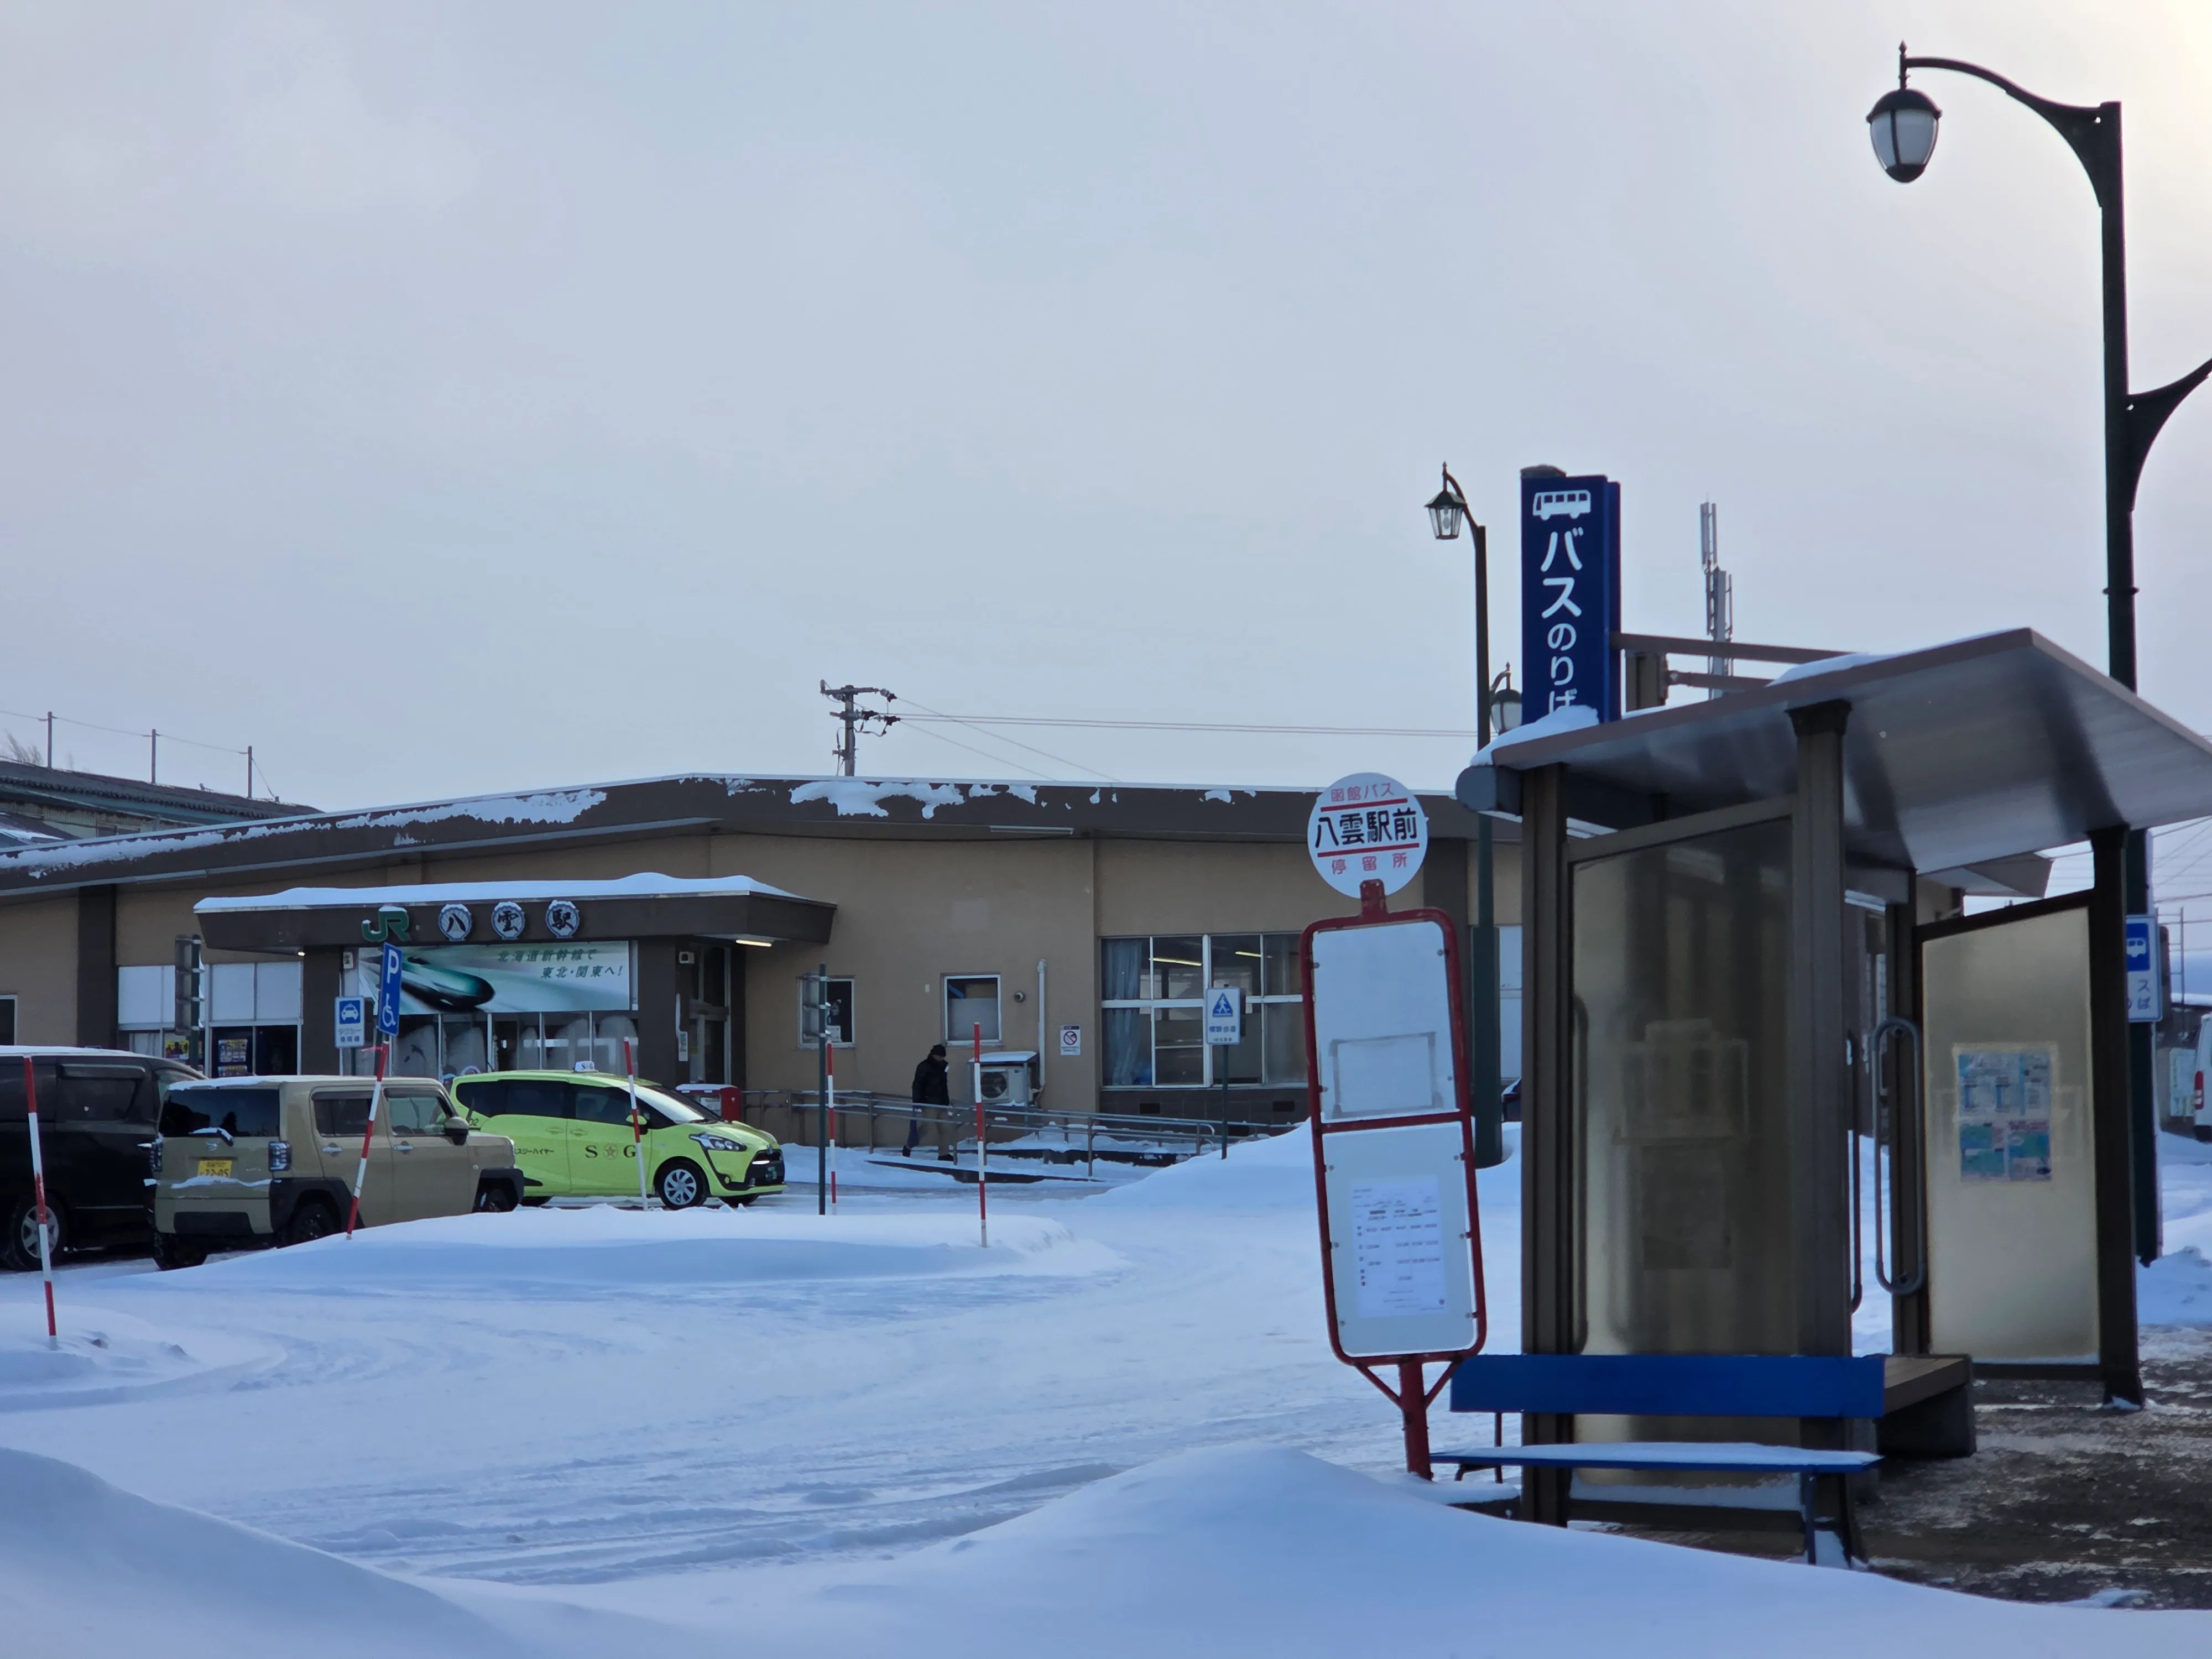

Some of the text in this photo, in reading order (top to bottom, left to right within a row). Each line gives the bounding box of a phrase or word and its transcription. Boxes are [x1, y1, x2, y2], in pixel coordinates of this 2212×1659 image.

[1541, 527, 1584, 714] バスのりば
[1331, 782, 1394, 802] 函館バス
[1314, 807, 1417, 848] 八雲駅前
[362, 909, 411, 942] JR
[387, 949, 400, 984] P
